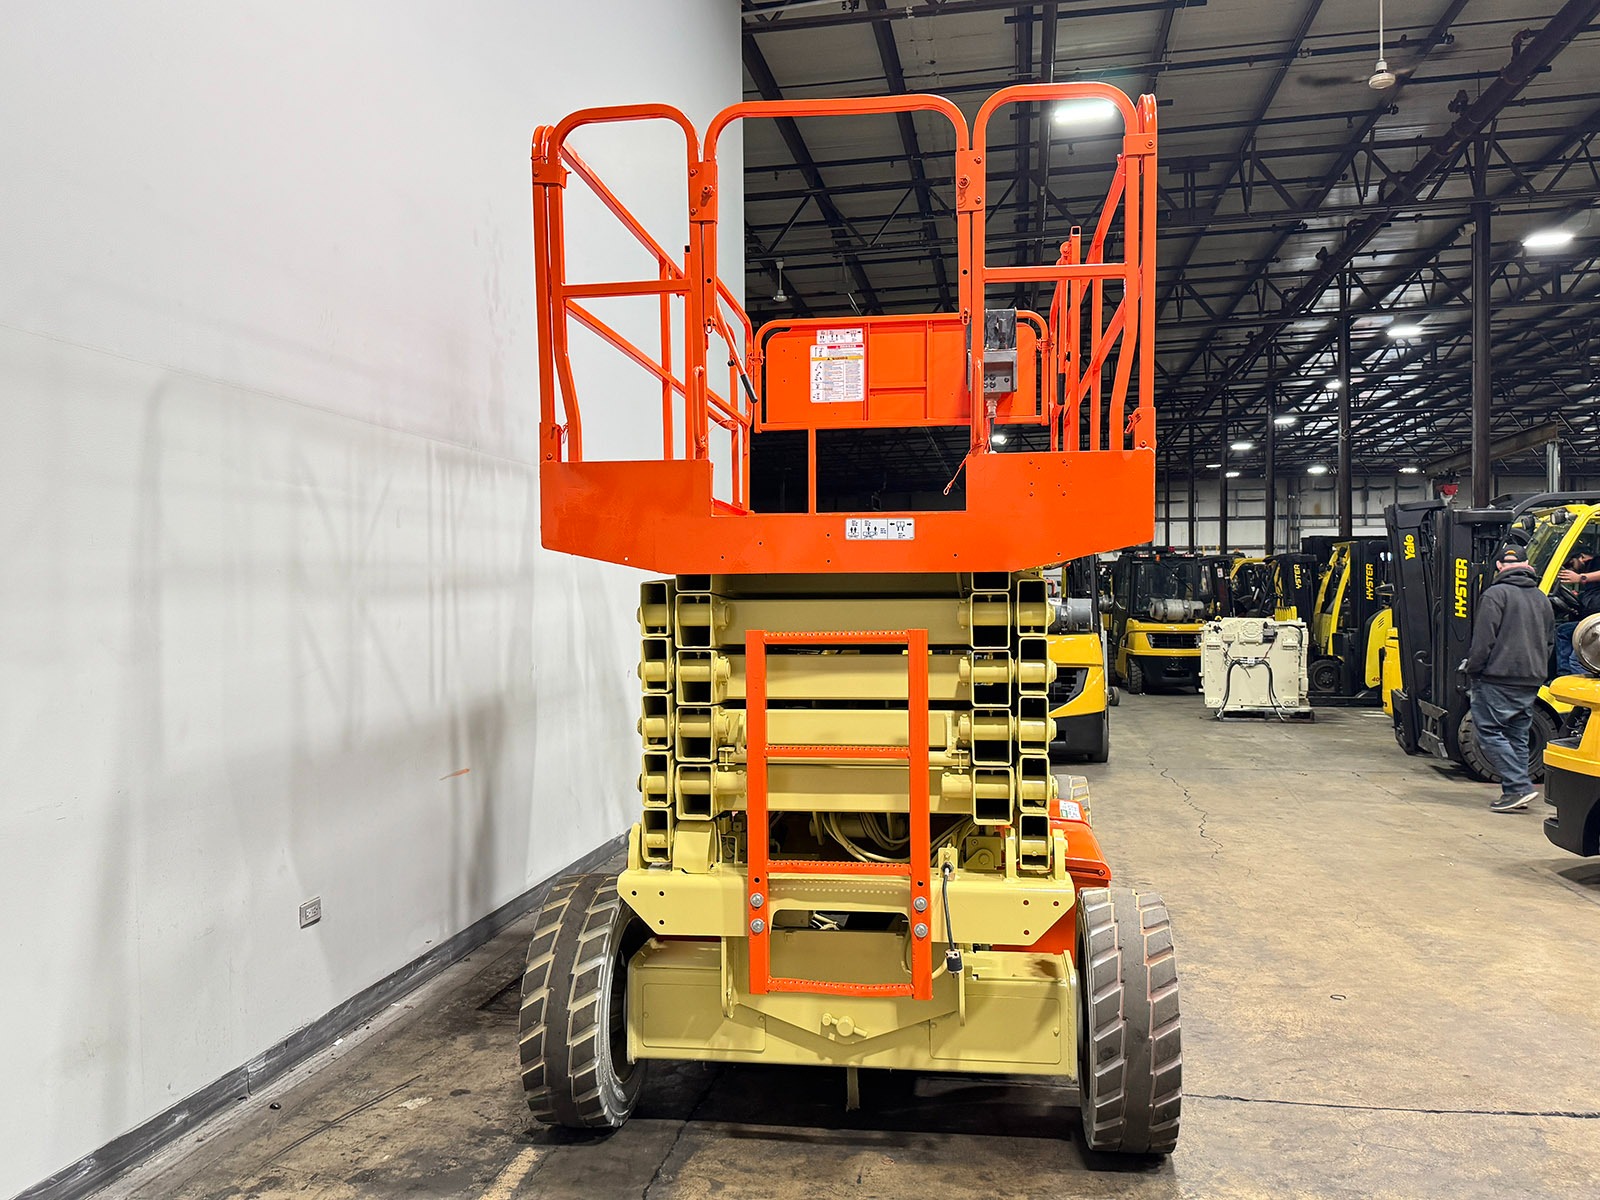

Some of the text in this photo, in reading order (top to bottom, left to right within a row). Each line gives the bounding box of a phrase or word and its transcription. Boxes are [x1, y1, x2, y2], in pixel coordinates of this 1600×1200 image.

[1403, 534, 1416, 560] Yale
[1365, 563, 1374, 600] HYSTER
[1455, 558, 1468, 618] HYSTER
